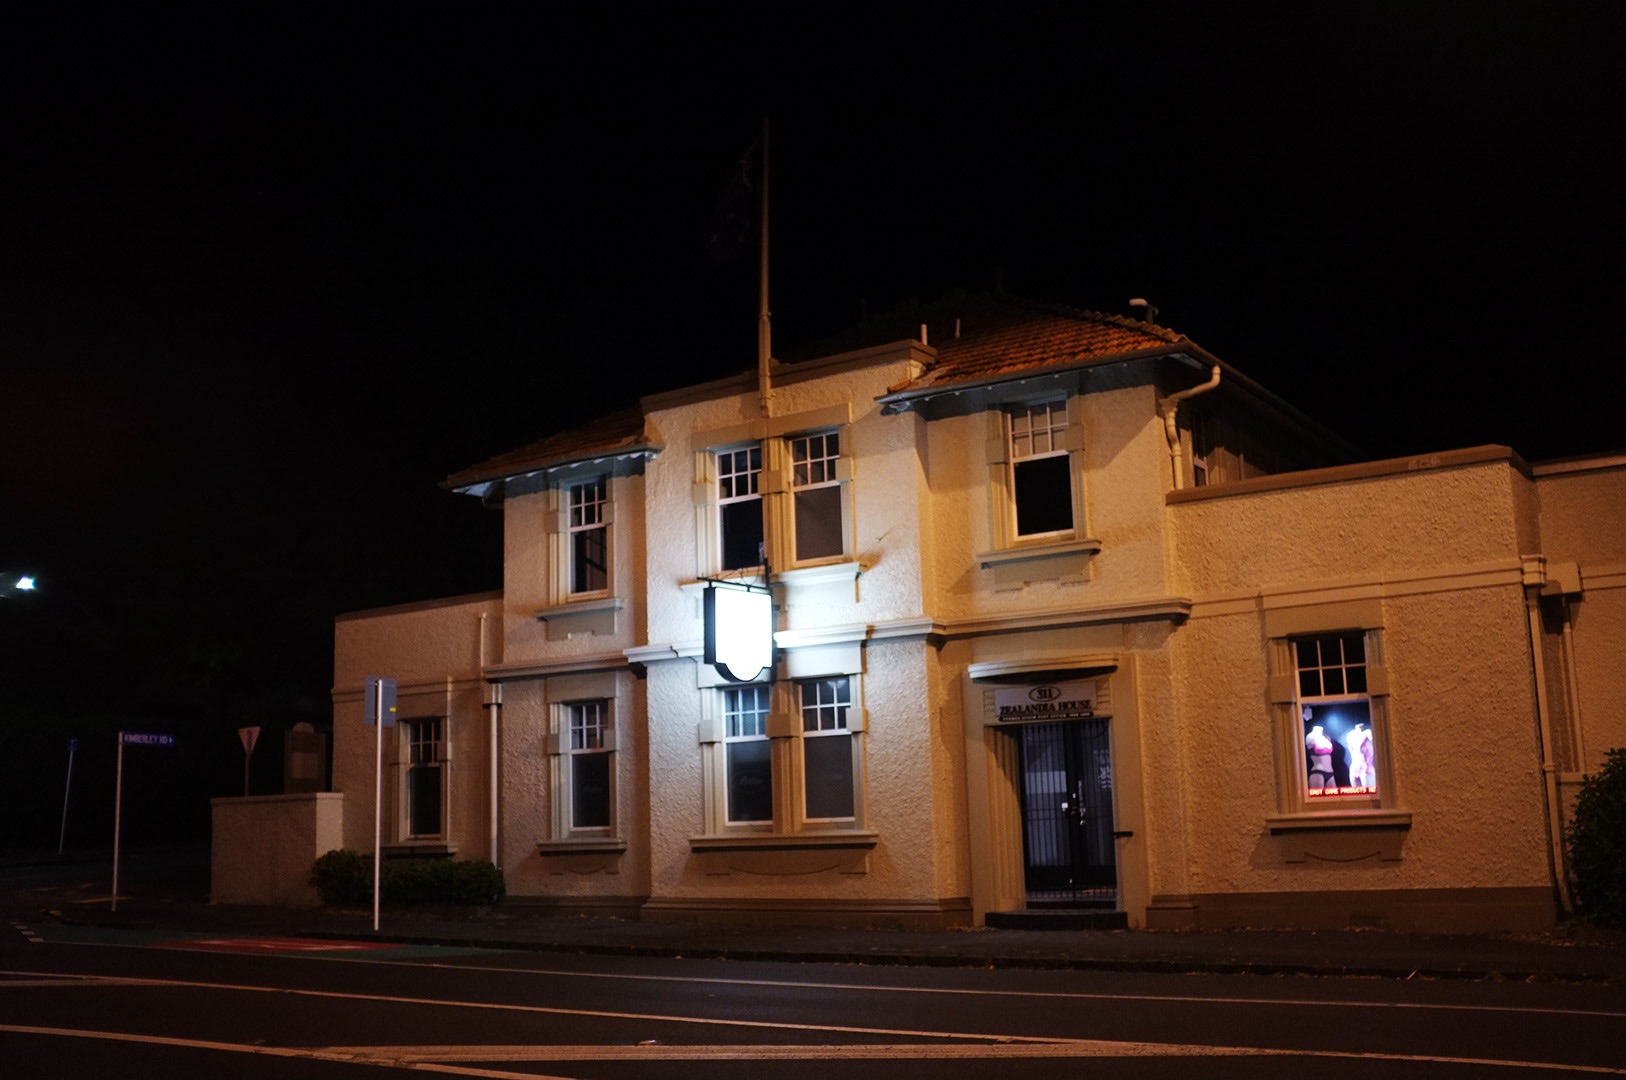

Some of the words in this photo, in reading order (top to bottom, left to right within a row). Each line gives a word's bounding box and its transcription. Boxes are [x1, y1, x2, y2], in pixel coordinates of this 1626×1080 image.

[1037, 688, 1052, 699] 311
[1000, 704, 1055, 715] ZEALANDIA
[1058, 700, 1091, 711] HOUSE
[1340, 786, 1366, 794] PRODUCTS
